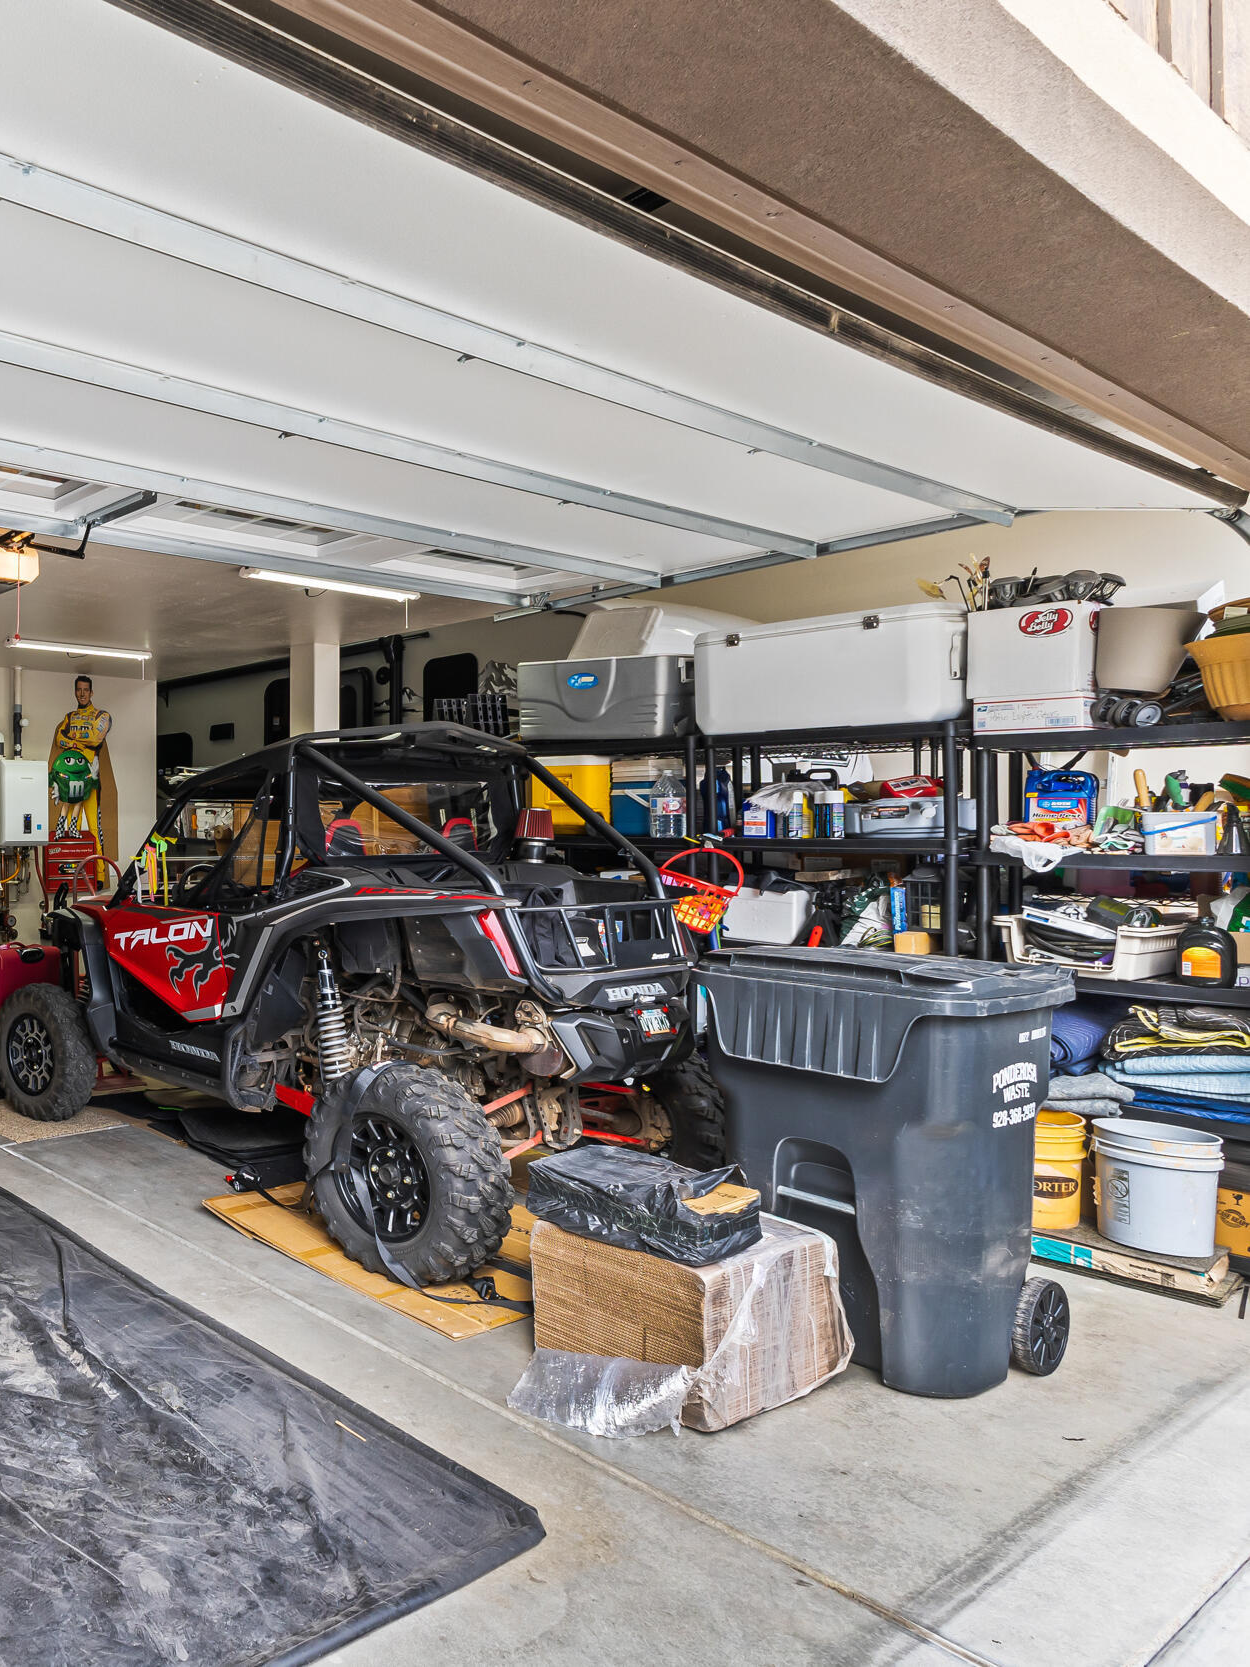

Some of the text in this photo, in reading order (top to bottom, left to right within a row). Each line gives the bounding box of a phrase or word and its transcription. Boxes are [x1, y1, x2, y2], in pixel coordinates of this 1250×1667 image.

[1027, 621, 1054, 632] Belly
[1037, 611, 1059, 623] Jelly
[113, 918, 214, 951] TALON
[604, 982, 668, 1003] HONDA
[168, 1039, 222, 1063] HONDA
[992, 1062, 1038, 1093] PONDEROSA
[1002, 1082, 1031, 1103] WASTE
